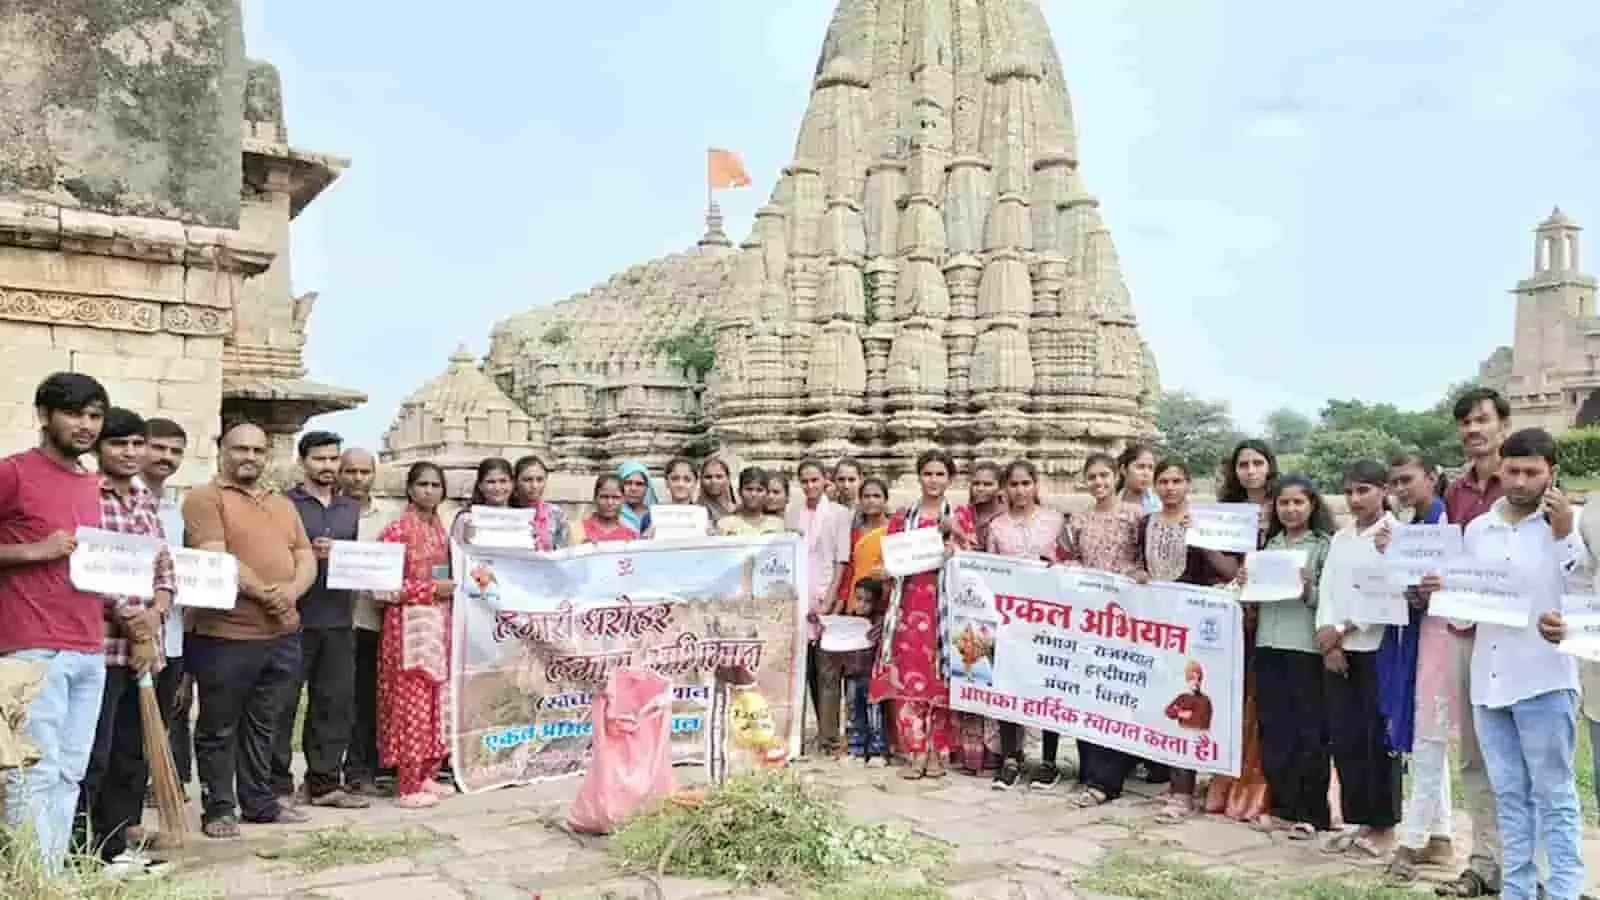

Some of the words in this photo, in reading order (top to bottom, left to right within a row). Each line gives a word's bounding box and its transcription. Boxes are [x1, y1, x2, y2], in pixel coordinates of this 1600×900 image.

[993, 593, 1072, 629] एकल
[1079, 600, 1189, 655] अभियान
[959, 686, 1018, 710] आपका
[1023, 695, 1079, 722] हार्दिक
[1080, 711, 1140, 740] स्वागत
[1143, 727, 1187, 755] करता
